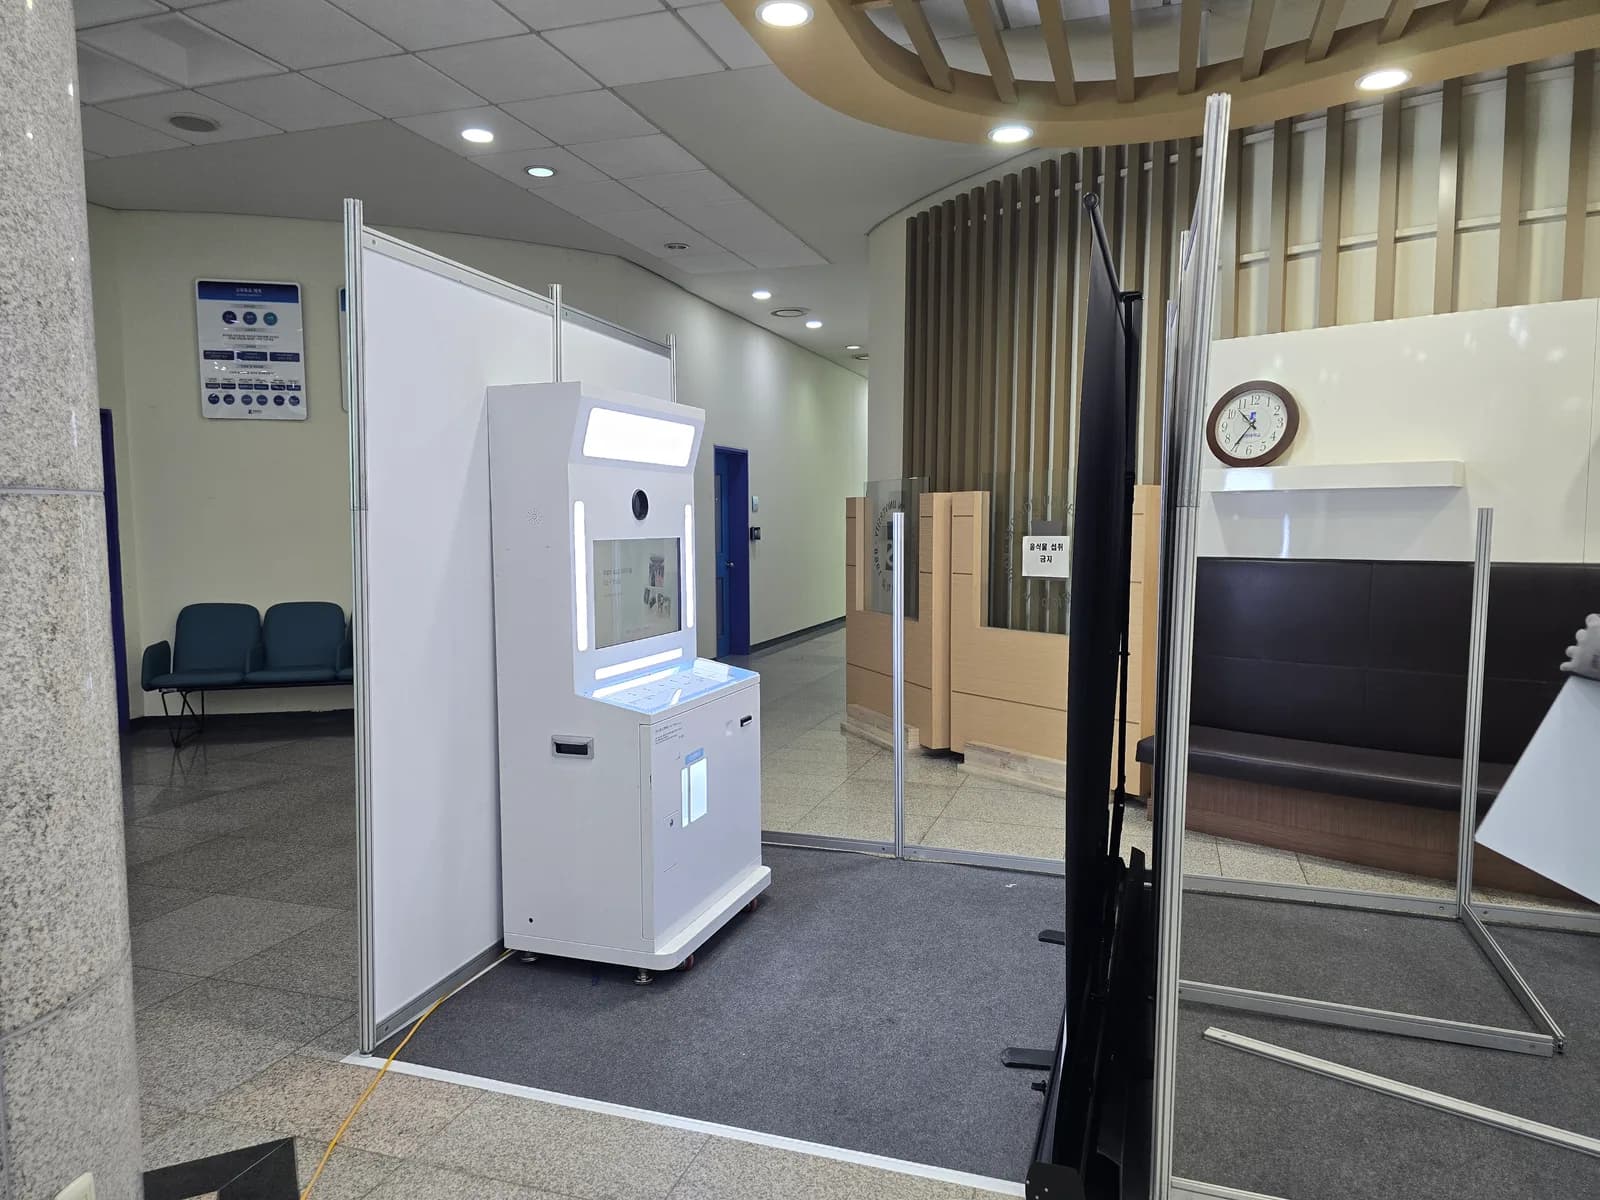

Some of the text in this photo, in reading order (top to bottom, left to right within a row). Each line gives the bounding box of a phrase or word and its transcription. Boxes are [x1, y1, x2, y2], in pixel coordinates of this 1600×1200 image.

[1238, 399, 1246, 409] 11
[1250, 394, 1260, 406] 12
[1266, 397, 1271, 407] 1
[1228, 408, 1236, 419] 10
[1274, 406, 1281, 416] 2
[1222, 422, 1228, 432] 9
[1276, 418, 1284, 428] 3
[1224, 434, 1230, 443] 8
[1270, 432, 1276, 442] 4
[1246, 445, 1252, 455] 6
[1260, 441, 1266, 452] 5
[1030, 543, 1064, 552] 음식물 섭취
[1040, 555, 1053, 563] 금지
